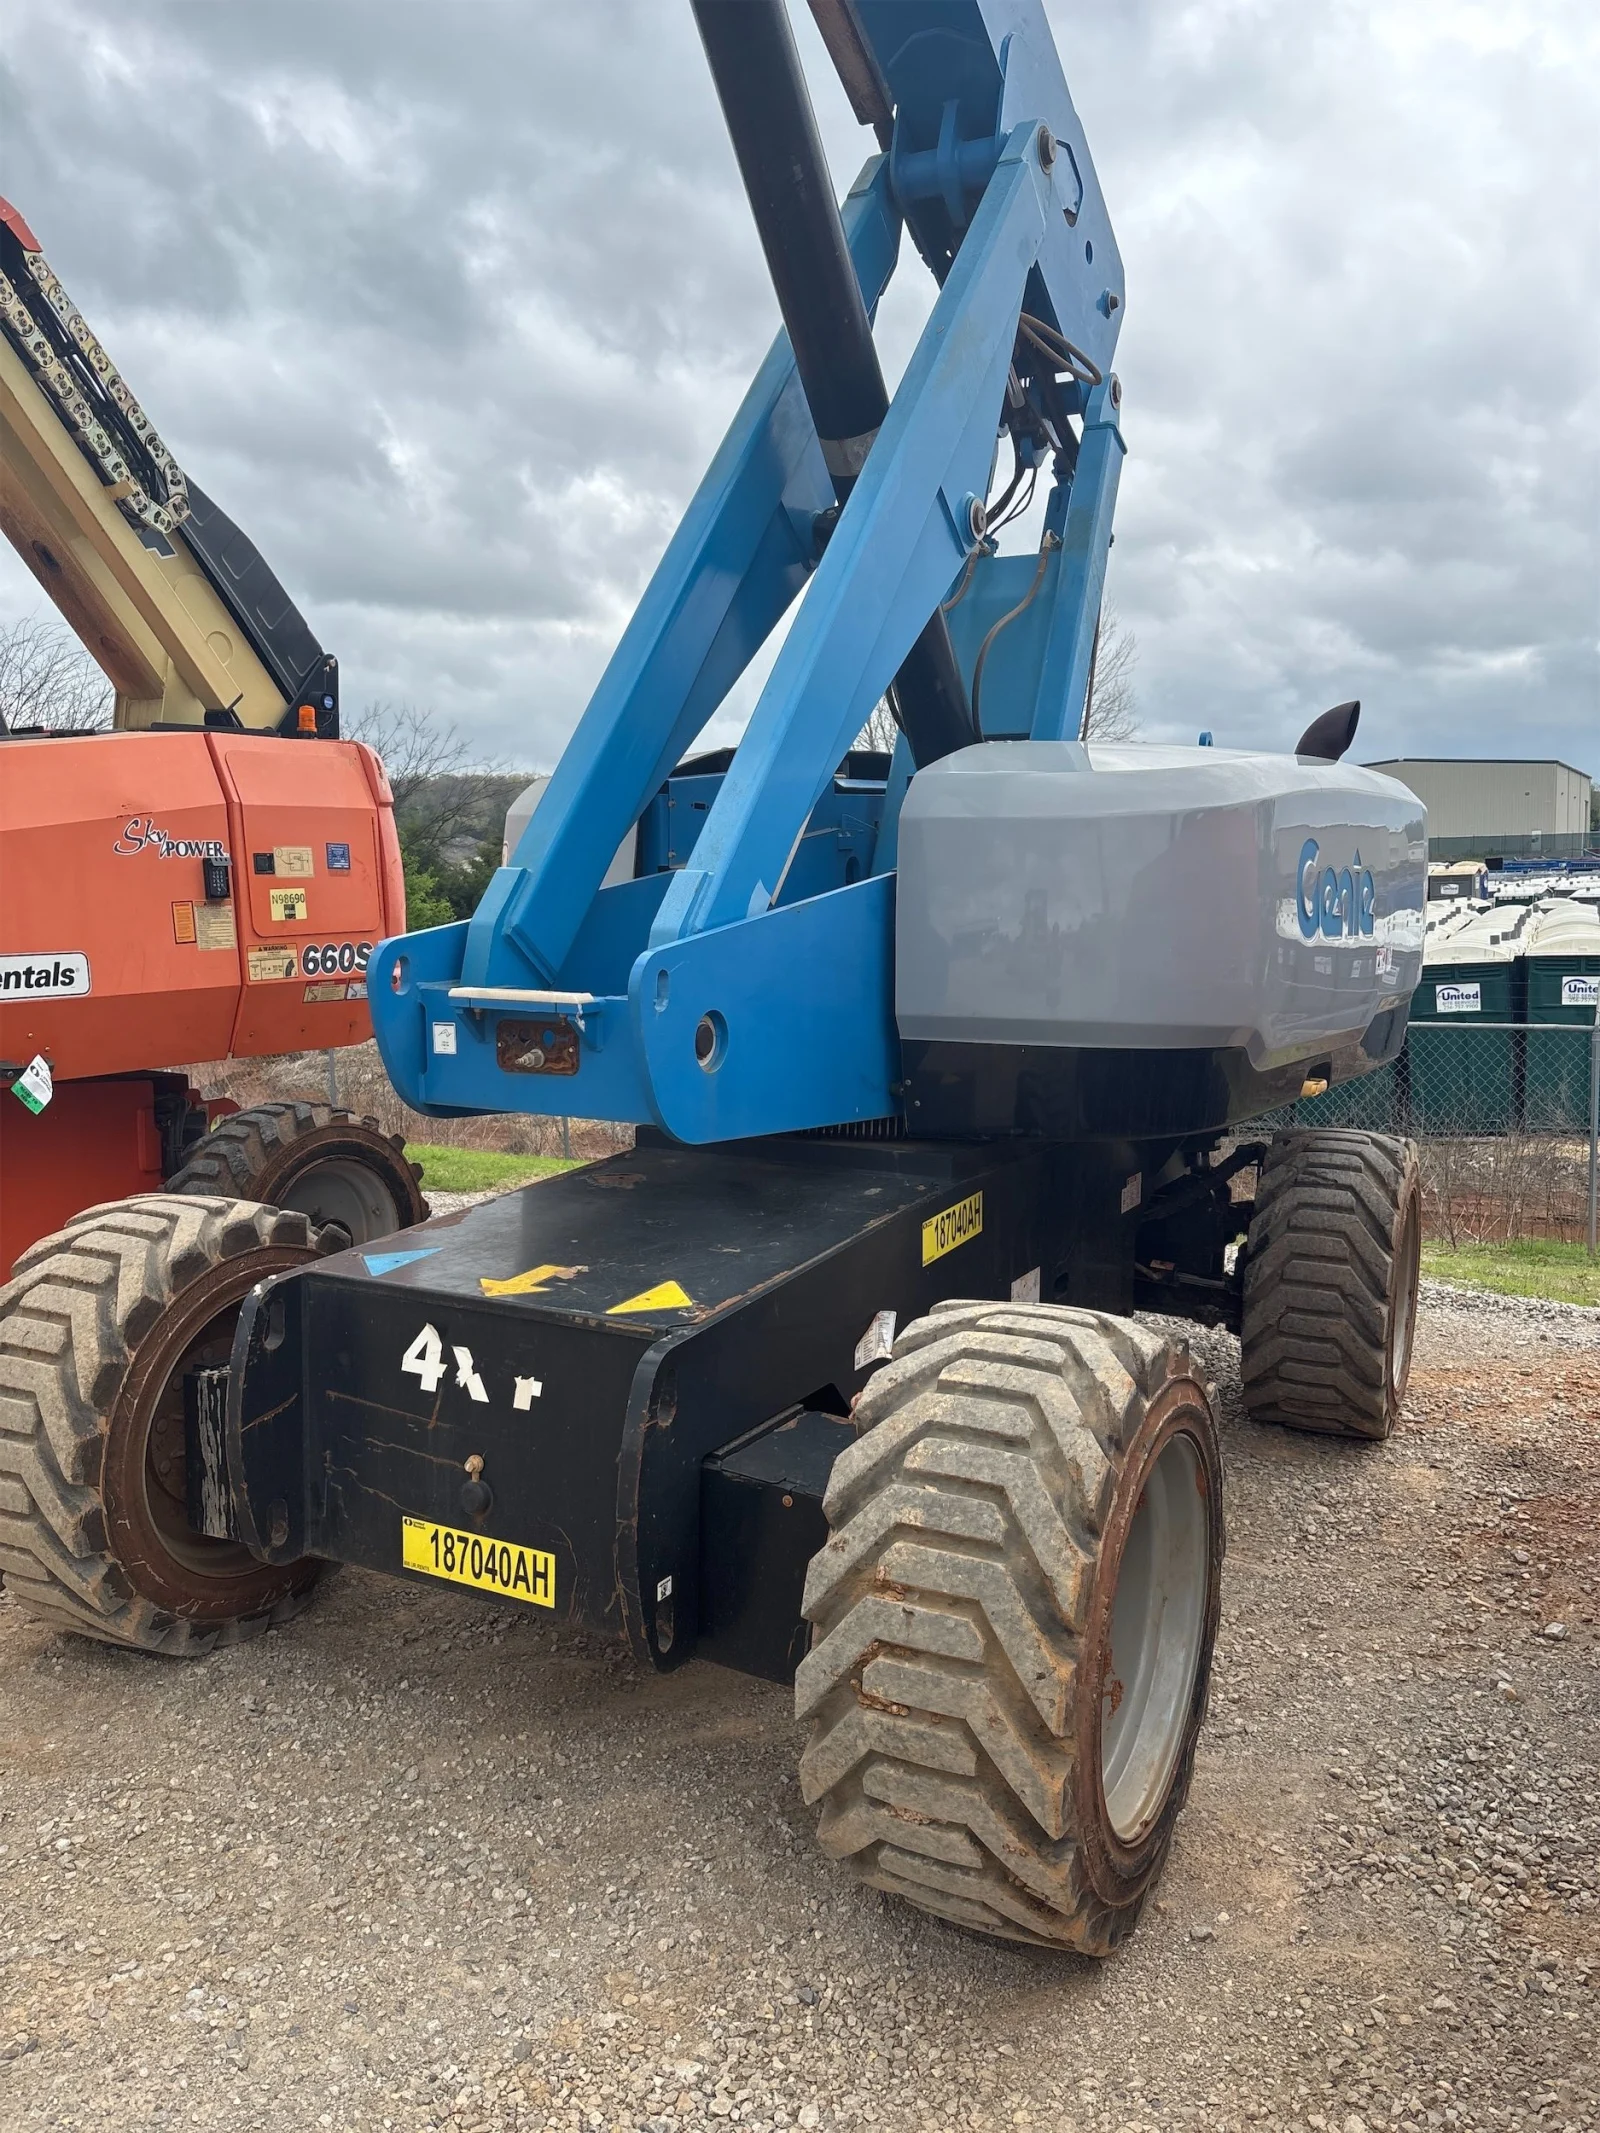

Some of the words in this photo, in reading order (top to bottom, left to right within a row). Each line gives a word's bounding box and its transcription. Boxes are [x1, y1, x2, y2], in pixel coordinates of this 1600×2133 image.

[271, 892, 306, 906] N98690
[1297, 838, 1375, 941] Genie
[302, 942, 375, 976] 660S
[0, 961, 76, 990] ntals
[1568, 984, 1599, 993] Unite
[1441, 991, 1479, 1001] United
[934, 1195, 981, 1252] 187040AH
[430, 1528, 549, 1598] 187040AH
